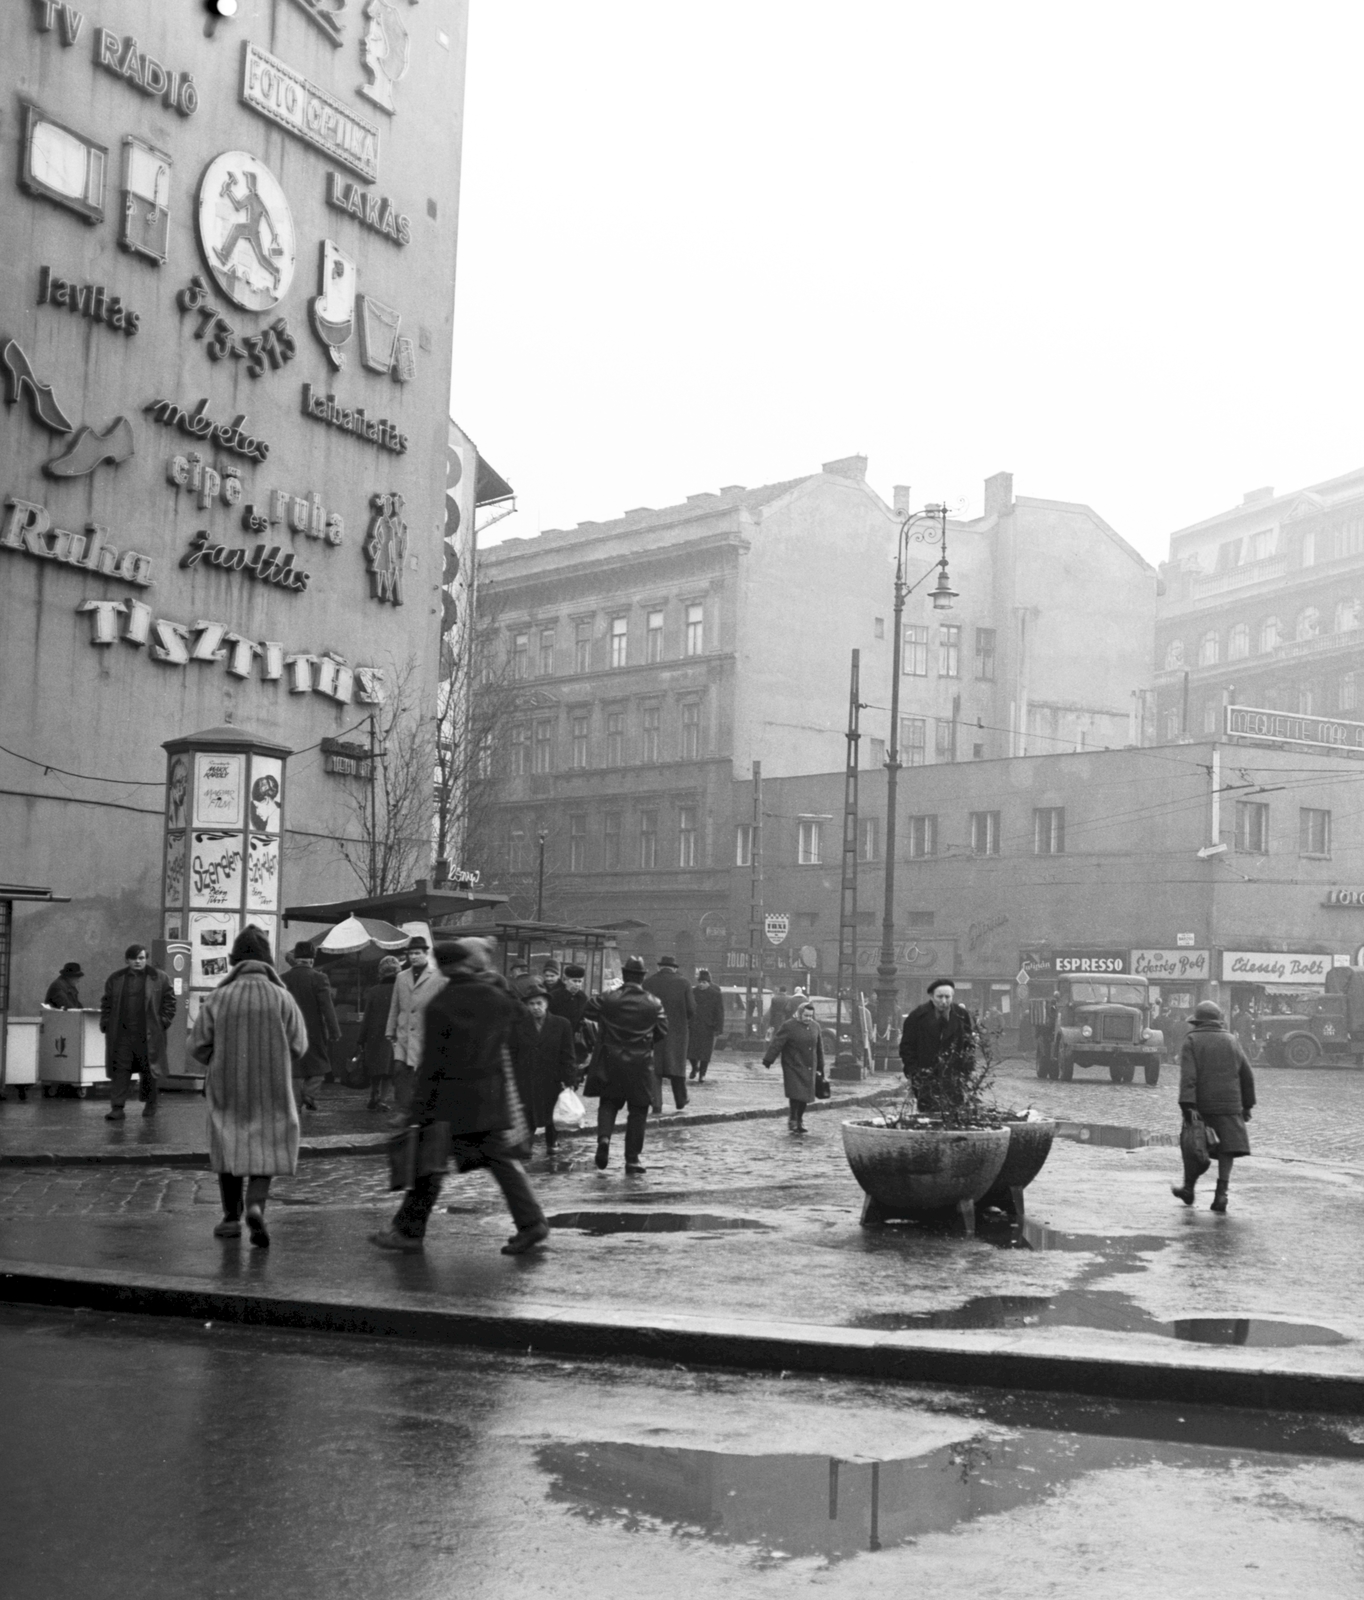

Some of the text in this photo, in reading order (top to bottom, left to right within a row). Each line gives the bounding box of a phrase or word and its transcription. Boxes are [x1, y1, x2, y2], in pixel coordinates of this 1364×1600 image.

[42, 0, 199, 116] TV RÁDIÓ
[249, 58, 377, 166] FOTO OPTIKA
[328, 171, 411, 246] LAKÁS
[148, 398, 269, 462] méretes
[1, 497, 156, 586] Ruha
[244, 505, 268, 532] és
[271, 489, 344, 546] ruha
[193, 848, 243, 893] Szerelem
[1055, 958, 1123, 971] ESPRESSO
[1179, 953, 1205, 975] Bolt
[1231, 957, 1285, 978] Édesség
[1290, 960, 1323, 975] Bolt
